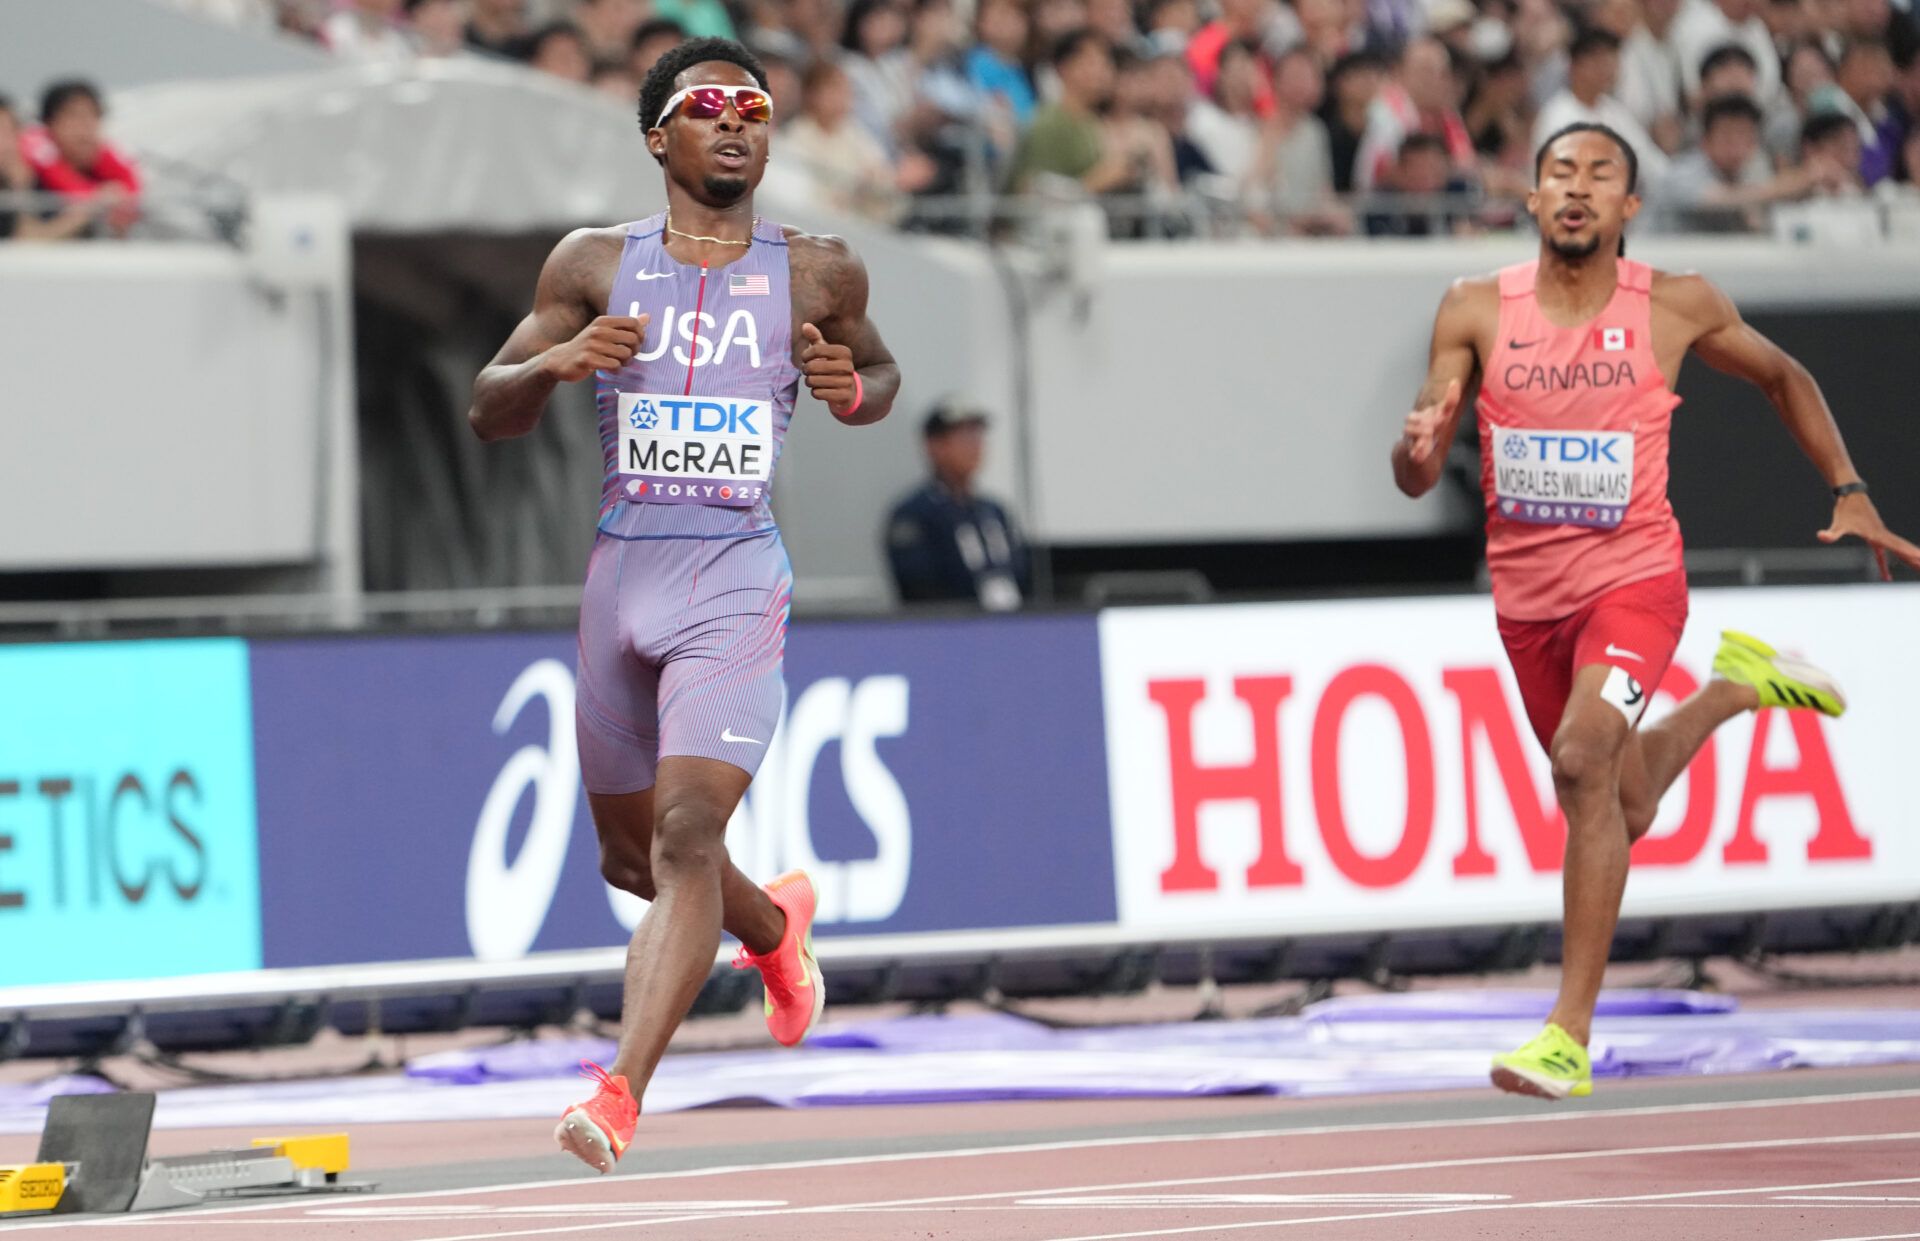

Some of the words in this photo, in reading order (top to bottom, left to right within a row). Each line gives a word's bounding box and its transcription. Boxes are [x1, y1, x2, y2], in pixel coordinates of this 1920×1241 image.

[629, 301, 761, 368] USA
[1504, 361, 1636, 391] CANADA
[659, 400, 761, 435] TDK
[629, 438, 761, 475] McRAE
[1529, 436, 1620, 463] TDK
[1498, 465, 1559, 497] MORALES
[1562, 471, 1628, 499] WILLIAMS
[20, 1179, 60, 1198] SEIKO
